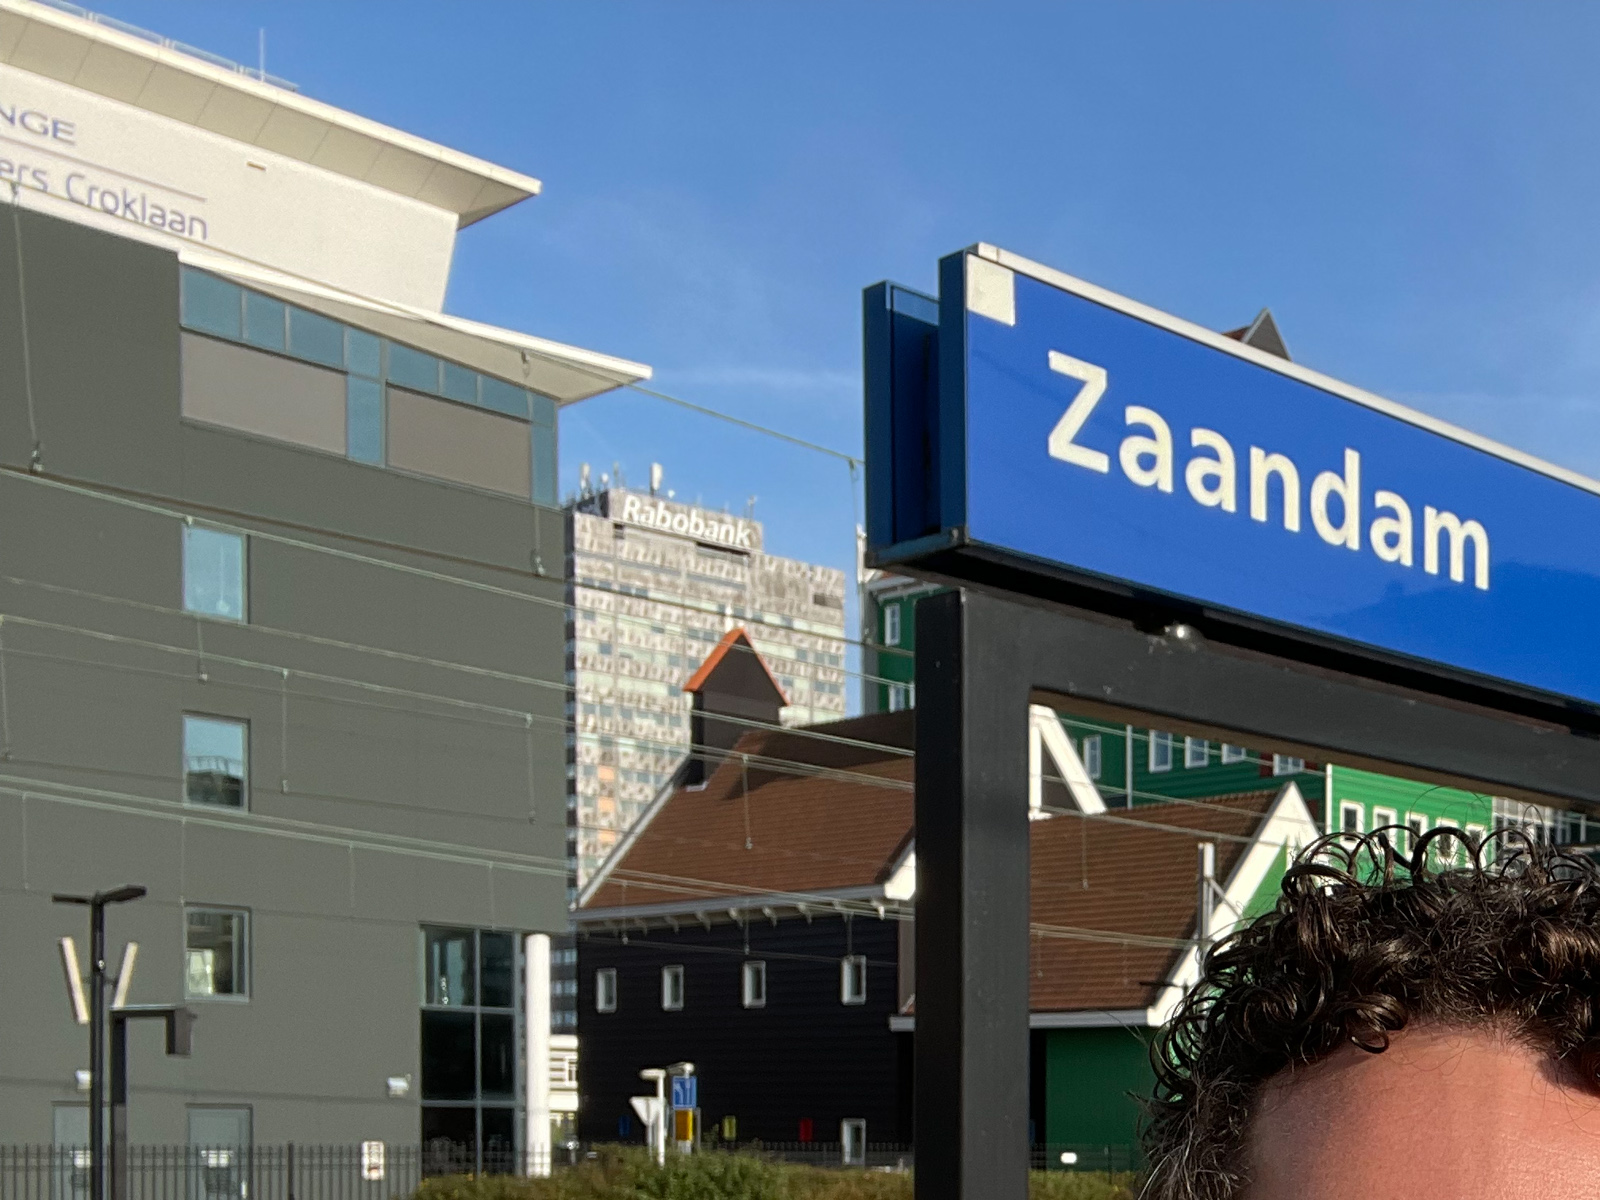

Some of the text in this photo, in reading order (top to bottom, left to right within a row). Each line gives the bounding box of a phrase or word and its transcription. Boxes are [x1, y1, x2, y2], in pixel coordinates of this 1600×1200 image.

[66, 171, 208, 240] Croklaan
[1048, 350, 1490, 591] Zaandam
[622, 494, 752, 547] Rabobank
